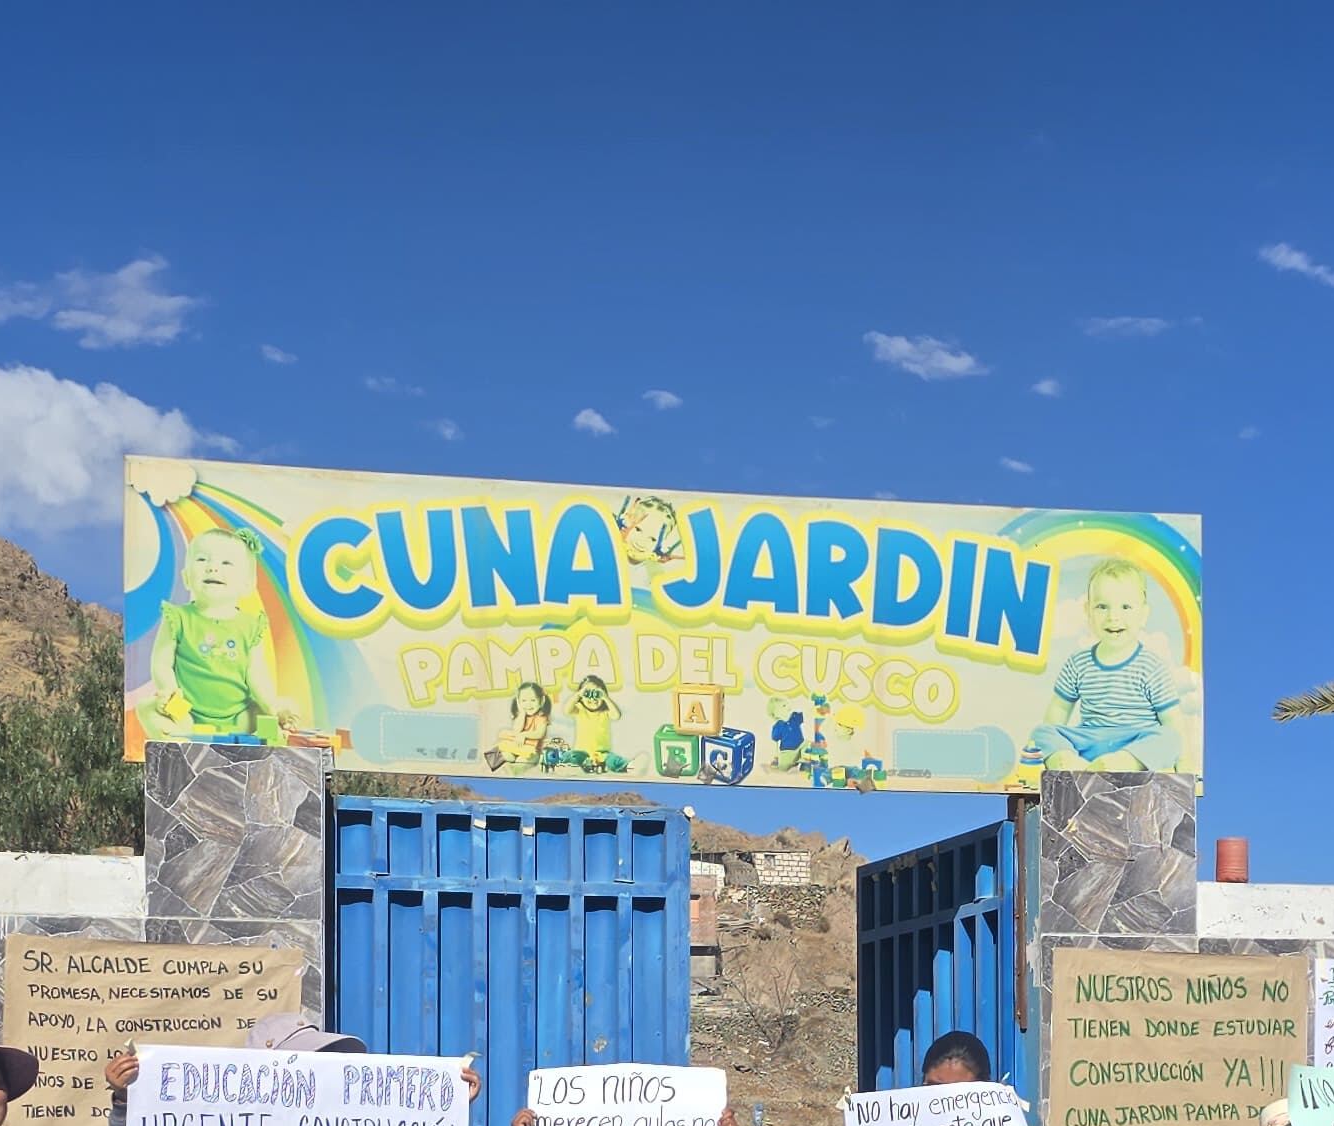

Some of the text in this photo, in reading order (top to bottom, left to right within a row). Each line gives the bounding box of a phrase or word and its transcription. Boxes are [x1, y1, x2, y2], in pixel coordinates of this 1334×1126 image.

[298, 504, 1050, 655] CUNA JARDIN
[402, 633, 955, 718] PAMPA DEL CUSCO
[23, 950, 263, 976] SR. ALCALDE CUMPLA SU
[27, 984, 277, 1004] PROMESA, NECESITAMOS DE SU
[1076, 974, 1289, 1005] NUESTROS NIÑOS NO
[28, 1011, 256, 1034] APOYO, LA CONSTRUCCIÓN DE
[1067, 1018, 1297, 1038] TIENEN DONDE ESTUDIAR
[71, 1076, 93, 1090] DE
[1069, 1059, 1204, 1087] CONSTRUCCIÓN
[342, 1064, 454, 1112] PRIMERO
[602, 1072, 676, 1104] niños
[22, 1104, 76, 1118] TIENEN
[929, 1089, 1018, 1121] emergencia
[1115, 1104, 1178, 1126] JARDIN
[1183, 1103, 1240, 1121] PAMPA
